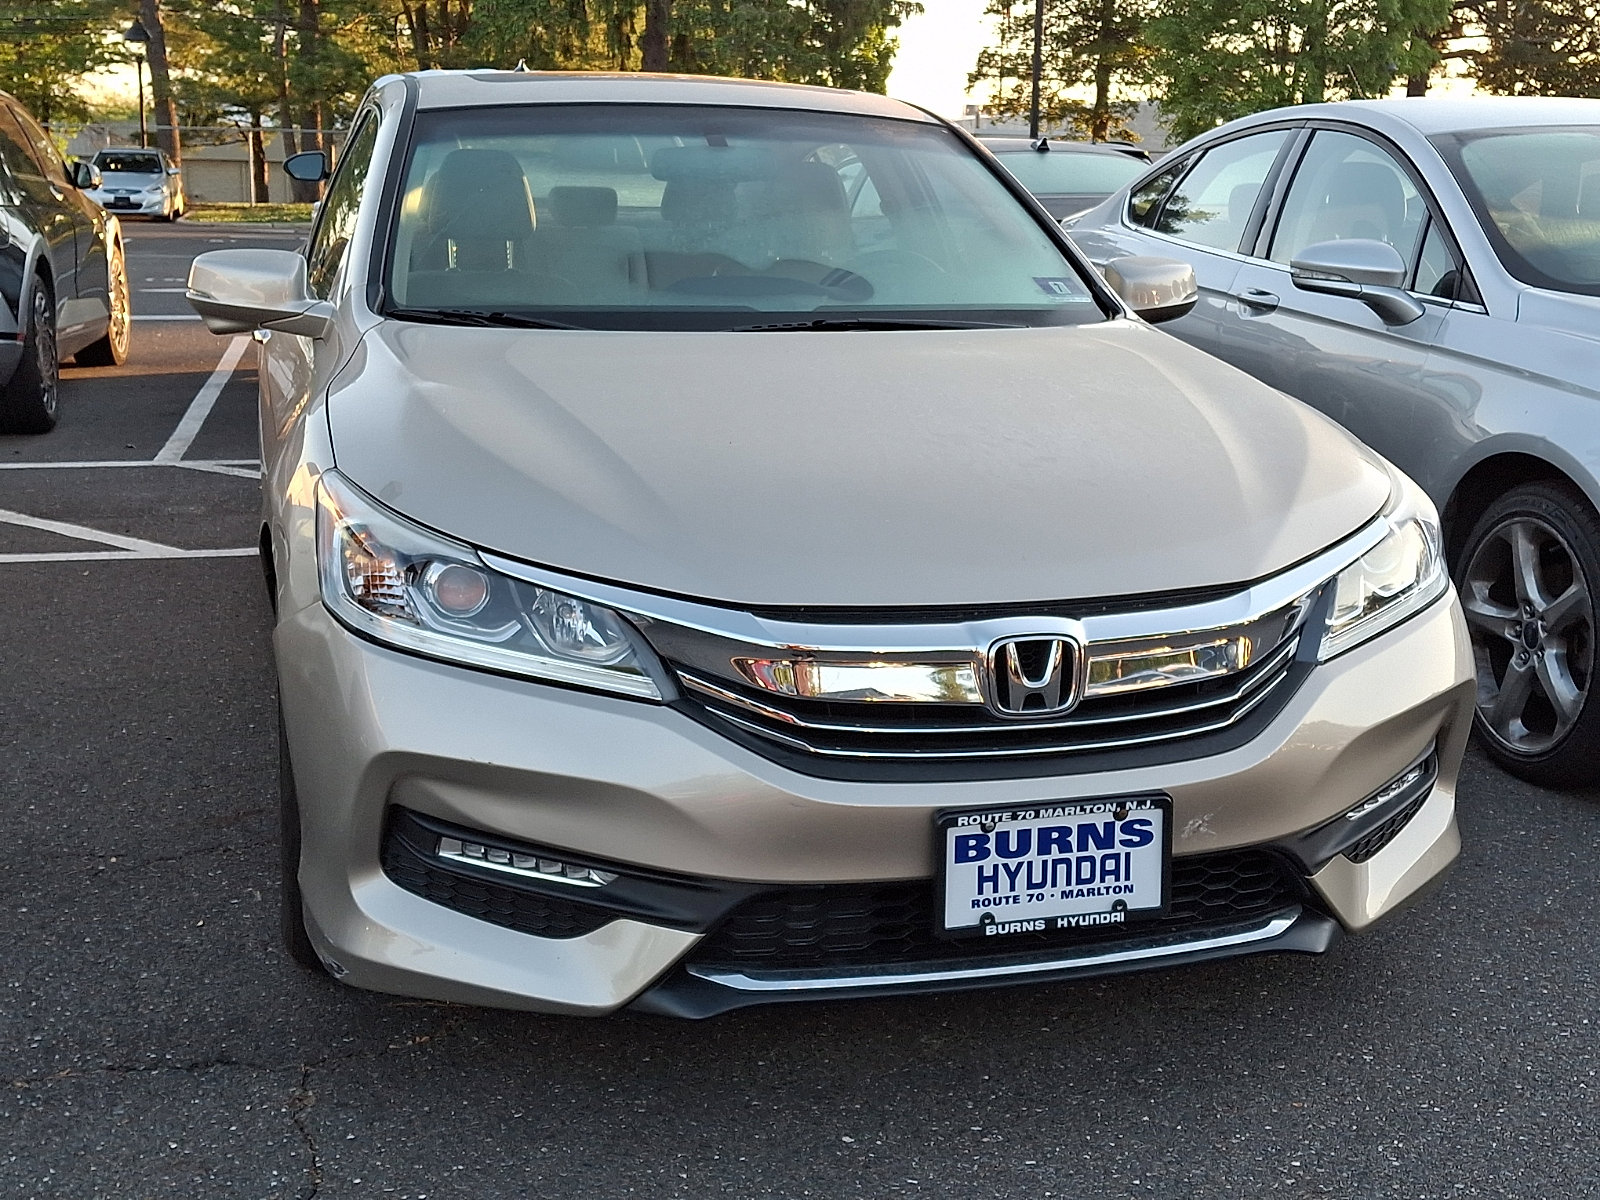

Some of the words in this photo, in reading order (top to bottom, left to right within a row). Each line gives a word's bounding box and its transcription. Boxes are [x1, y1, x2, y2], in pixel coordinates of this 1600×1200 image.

[957, 813, 1012, 827] ROUTE
[1016, 810, 1035, 821] 70
[1125, 800, 1155, 811] N.J.
[954, 818, 1155, 864] BURNS
[977, 851, 1131, 896] HYUNDAI
[971, 895, 1021, 909] ROUTE
[1026, 892, 1045, 903] 70
[1060, 884, 1134, 900] MARLTON
[985, 920, 1046, 936] BURNS
[1057, 911, 1125, 928] HYUNDAI
